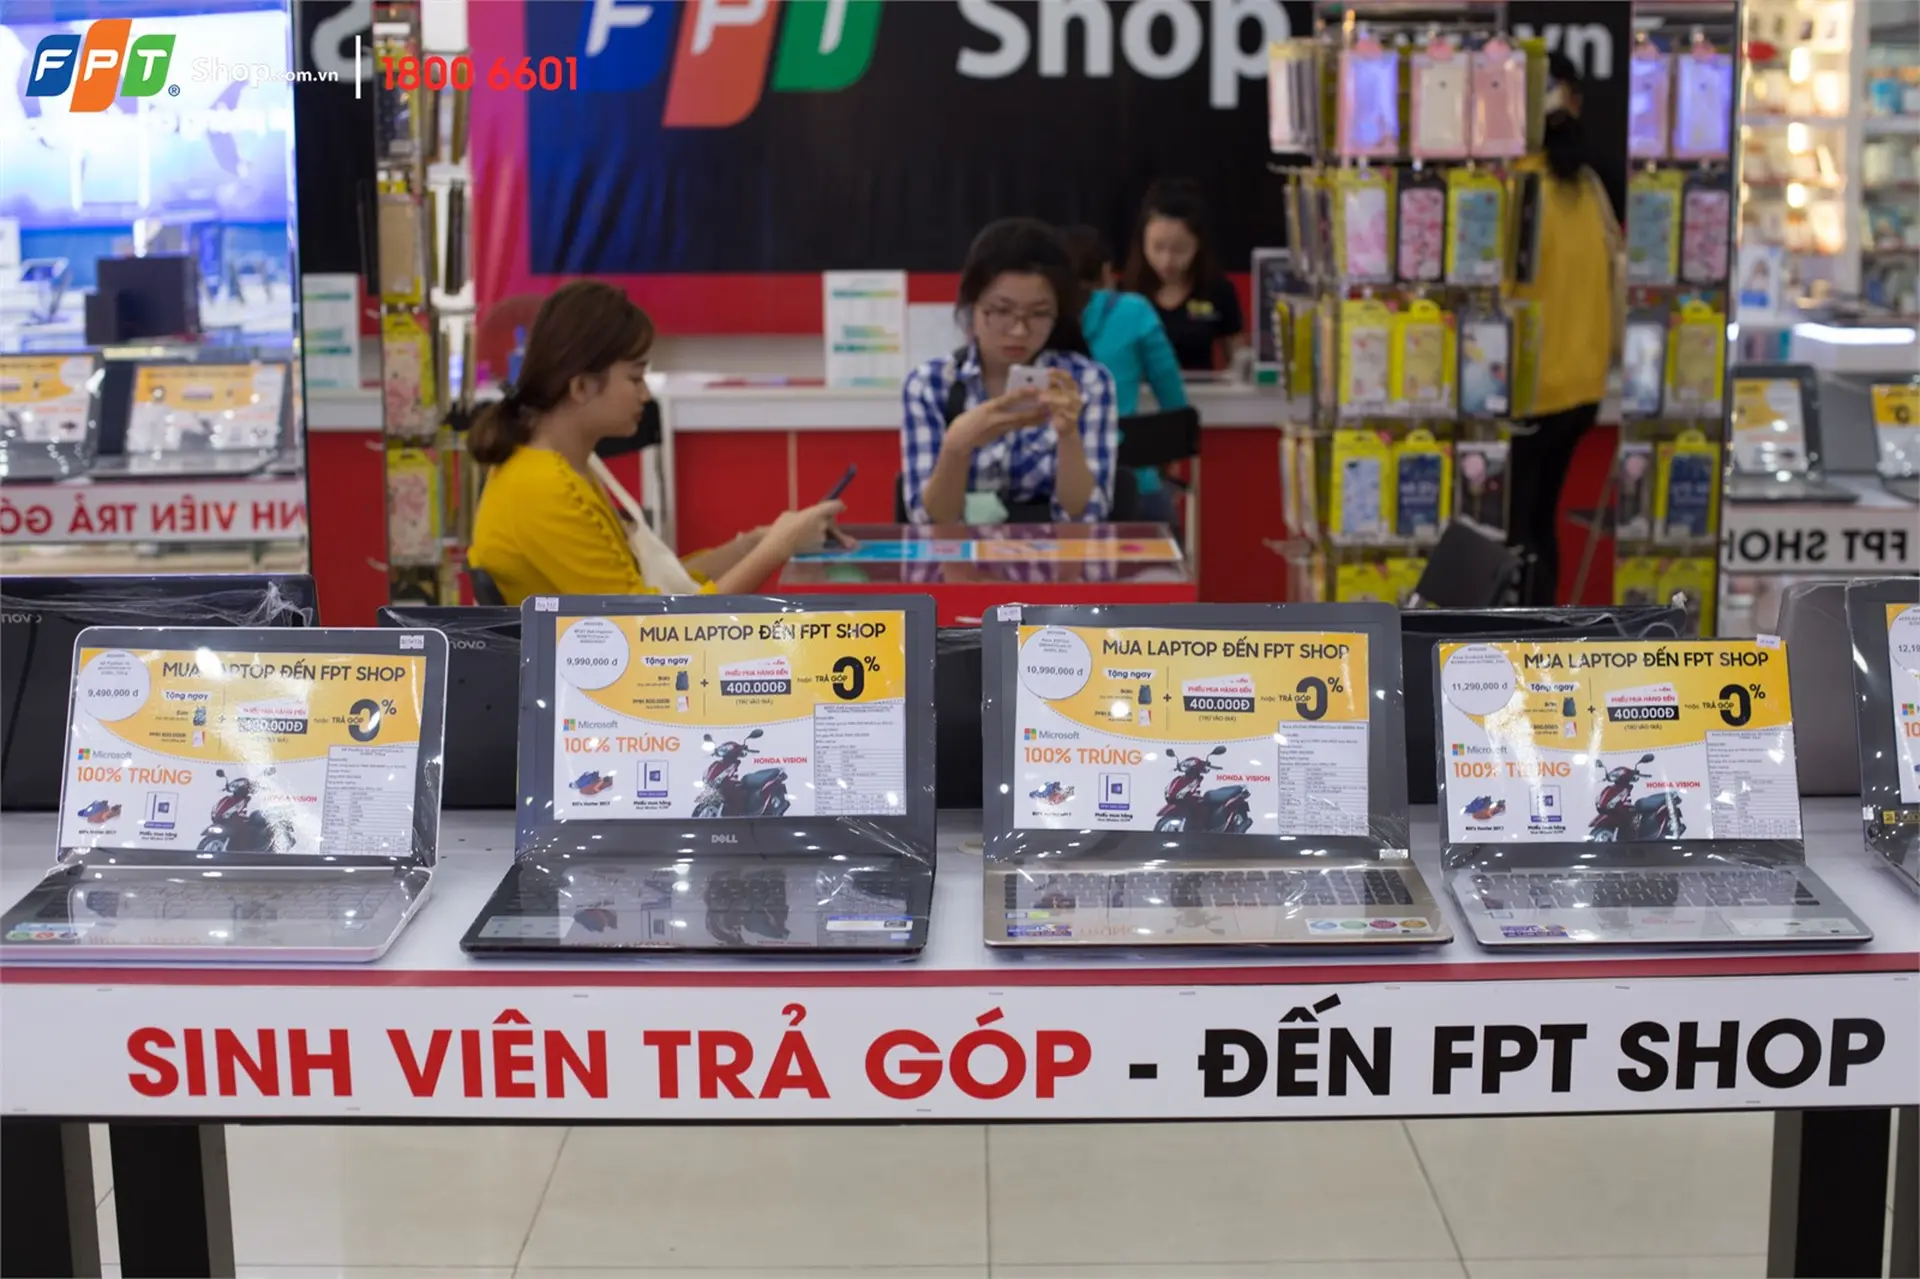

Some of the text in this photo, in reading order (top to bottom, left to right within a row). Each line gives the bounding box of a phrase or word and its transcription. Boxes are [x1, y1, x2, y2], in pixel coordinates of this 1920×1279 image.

[639, 618, 887, 643] MUA LAPTOP ĐẾN FPT SHOP
[1103, 635, 1350, 661] MUA LAPTOP ĐẾN FPT SHOP
[566, 657, 609, 667] 9,990,000
[1523, 653, 1564, 669] MUA
[1568, 652, 1637, 669] LAPTOP
[1643, 646, 1680, 668] ĐẾN
[1683, 651, 1715, 668] FPT
[1719, 651, 1769, 667] SHOP
[320, 665, 352, 682] FPT
[355, 666, 406, 682] SHOP
[1026, 665, 1075, 677] 10,990,000
[1130, 670, 1152, 679] ngay
[815, 673, 831, 684] TRẢ
[831, 674, 848, 684] GÓP
[726, 680, 788, 694] 400.000Đ
[1452, 682, 1500, 692] 11,290,000
[88, 688, 131, 698] 9,490,000
[1293, 693, 1312, 703] GÓP
[1189, 698, 1250, 711] 400.000Đ
[1613, 707, 1675, 720] 400.000Đ
[577, 720, 619, 730] Microsoft
[1038, 730, 1080, 741] Microsoft
[564, 732, 681, 753] 100% TRÚNG
[92, 749, 133, 760] Microsoft
[1024, 744, 1143, 766] 100% TRÚNG
[1466, 745, 1508, 755] Microft
[753, 756, 808, 765] HONDA VISION
[1453, 759, 1572, 778] 100% TNG
[77, 765, 193, 786] 100% TRÚNG
[1216, 774, 1271, 783] HONDA VISION
[711, 833, 738, 844] DELL
[126, 1026, 353, 1098] SINH
[386, 1008, 608, 1099] VIÊN
[643, 1003, 831, 1100] TRẢ
[864, 1007, 1093, 1100] GÓP
[1198, 993, 1392, 1098] ĐẾN
[1432, 1023, 1588, 1095] FPT
[1617, 1017, 1887, 1095] SHOP
